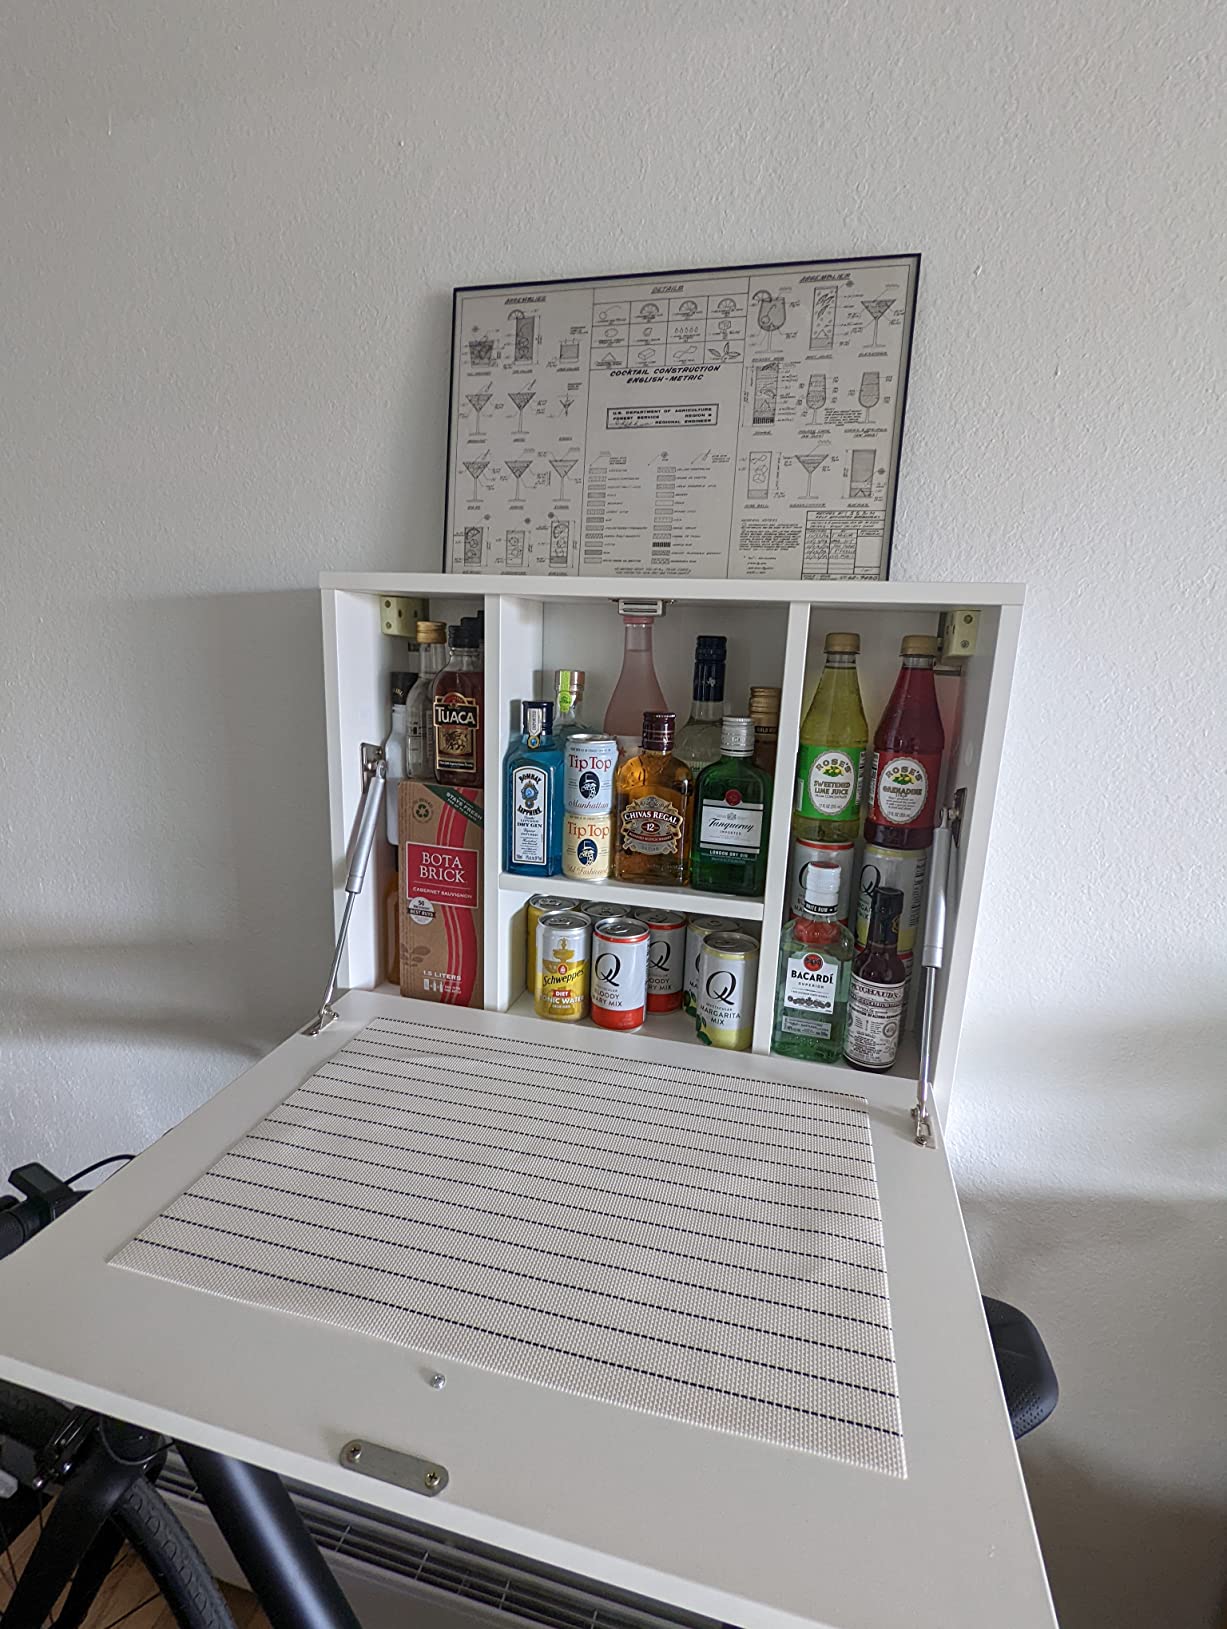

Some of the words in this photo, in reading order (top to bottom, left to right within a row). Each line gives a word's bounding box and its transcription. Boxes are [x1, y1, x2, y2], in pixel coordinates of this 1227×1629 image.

[610, 369, 649, 377] COCKTAIL
[653, 365, 720, 374] CONSTRUCTION
[435, 706, 476, 724] TUACA
[569, 754, 588, 772] Tip
[589, 756, 612, 772] Top
[815, 758, 852, 774] ROSE'S
[518, 773, 542, 784] BOMBAY
[886, 766, 923, 782] ROSE'S
[624, 811, 651, 821] CHIVAS
[653, 810, 678, 825] REGAL
[708, 817, 754, 832] Tanqueray
[567, 821, 586, 839] Tip
[588, 824, 610, 839] Top
[646, 823, 655, 831] 12
[422, 852, 463, 869] BOTA
[420, 865, 465, 883] BRICK
[412, 887, 440, 895] CABERNET
[434, 971, 462, 981] LITERS
[543, 969, 584, 987] Schweppes
[595, 953, 621, 987] Q
[705, 970, 737, 1006] Q
[700, 1005, 741, 1018] MARGARITA
[710, 1017, 725, 1025] MIX
